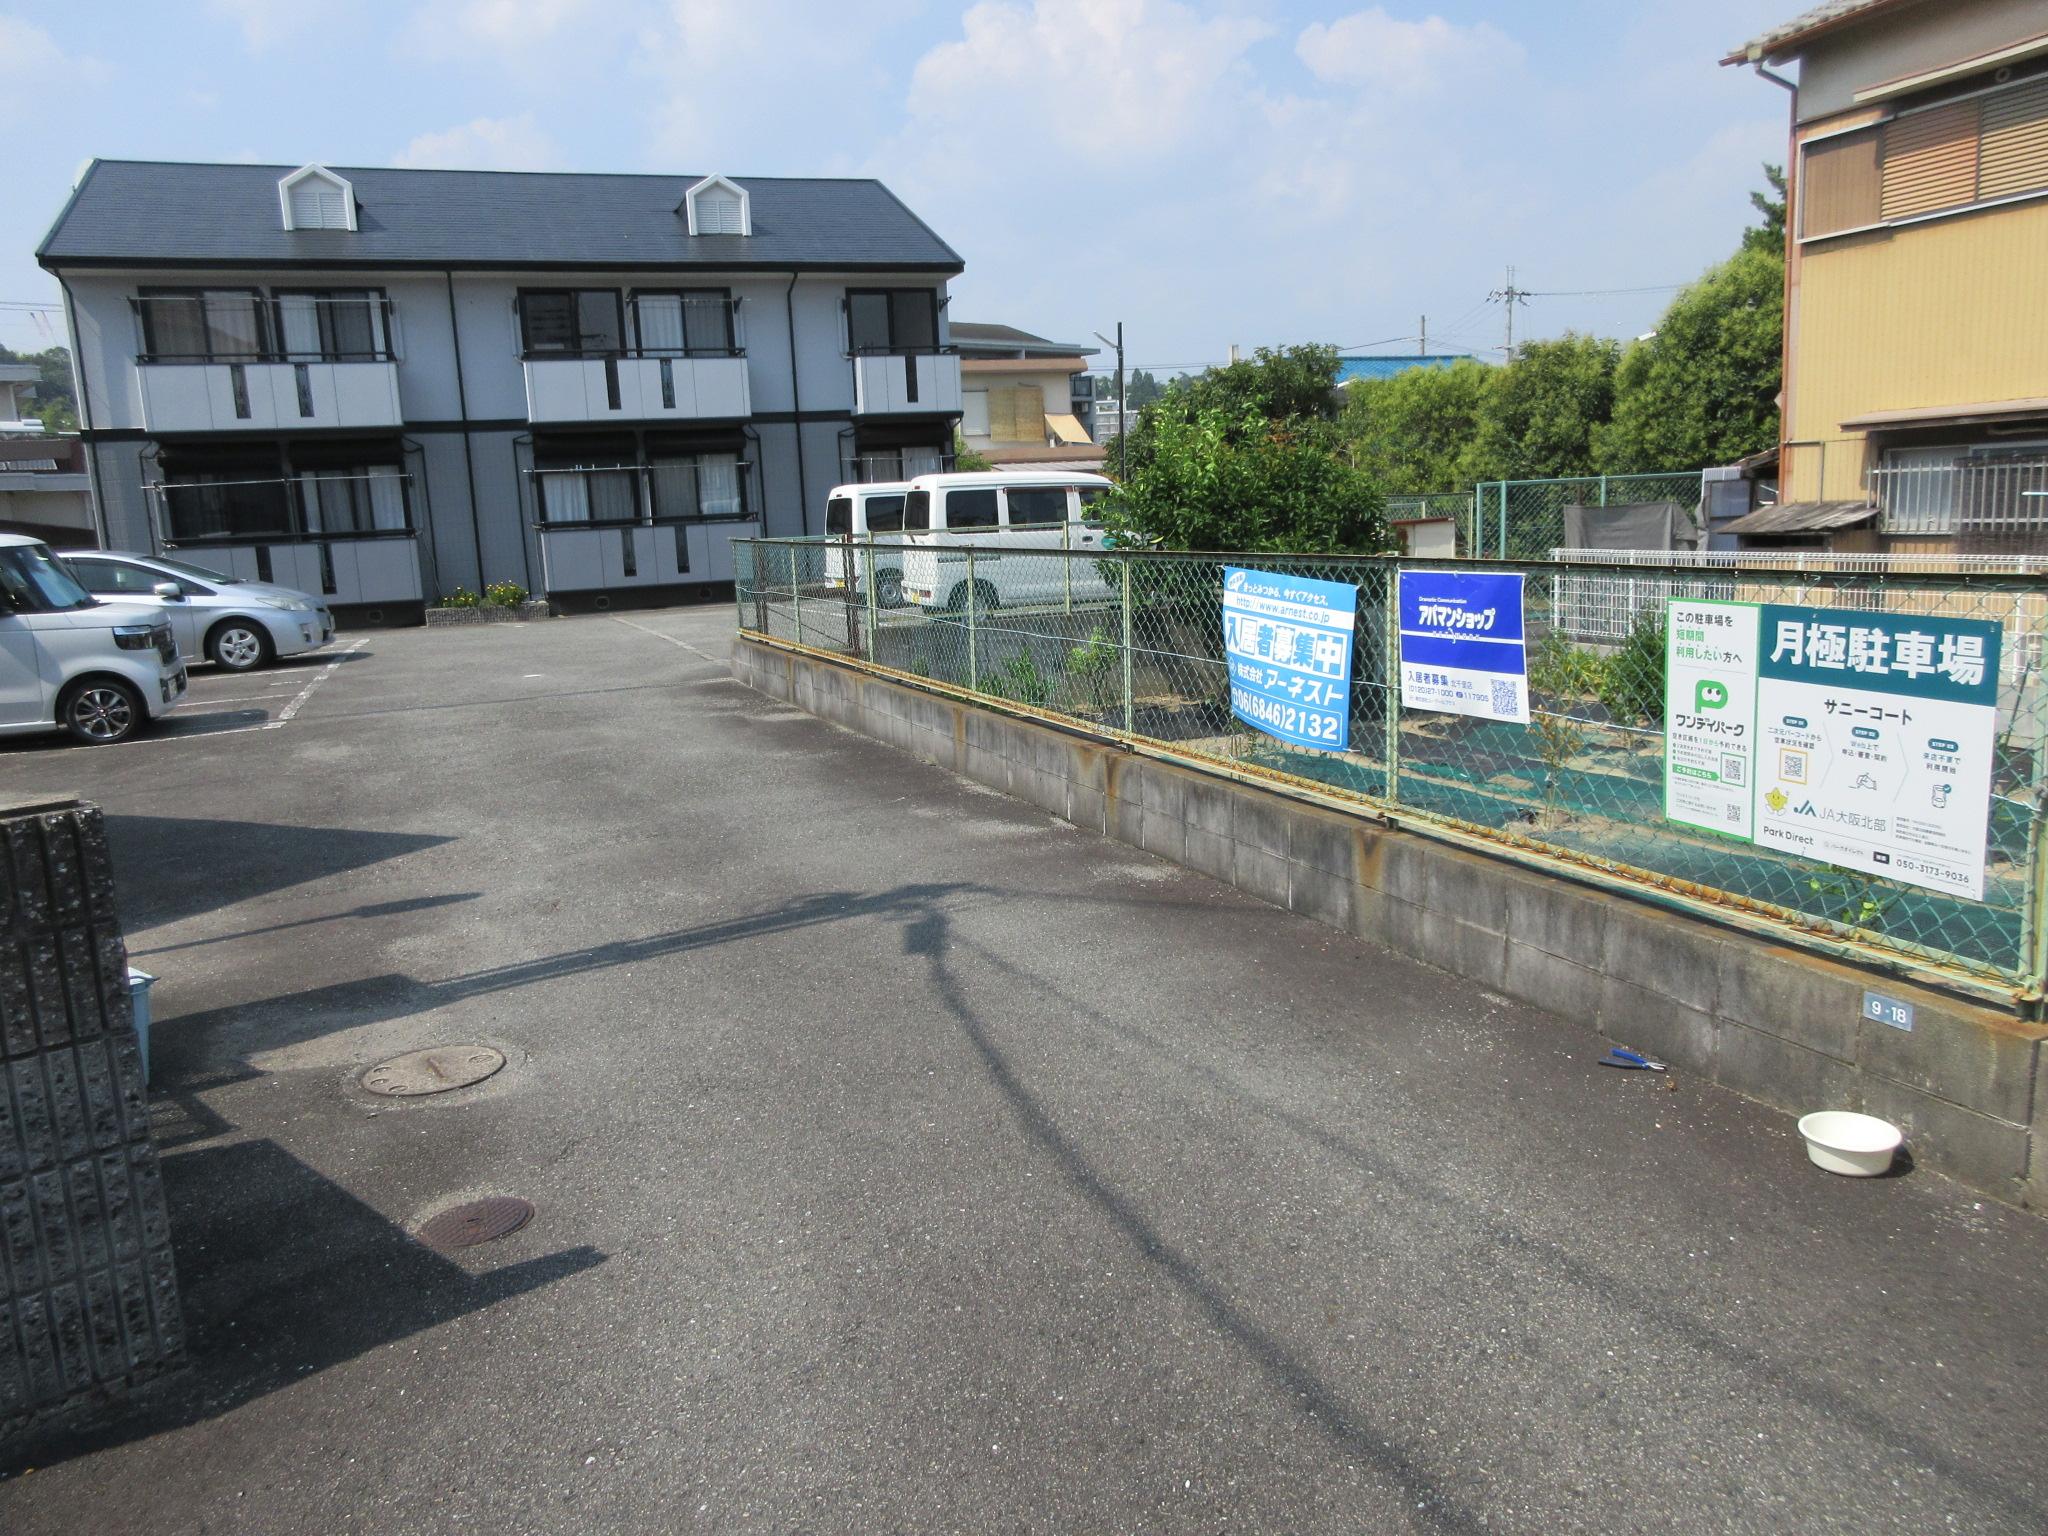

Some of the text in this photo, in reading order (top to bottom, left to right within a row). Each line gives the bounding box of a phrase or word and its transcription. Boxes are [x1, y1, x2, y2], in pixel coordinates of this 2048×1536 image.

[1236, 596, 1330, 624] http://www.arnest.co.jp
[1418, 604, 1496, 631] アパマンショップ
[1676, 612, 1733, 627] この駐車場を
[1226, 616, 1344, 674] 入居者募集中
[1676, 629, 1705, 642] 短期間
[1676, 646, 1743, 663] 利用したい方へ
[1770, 620, 1985, 686] 月極駐車場
[1408, 670, 1450, 687] 入居者募集
[1824, 699, 1913, 726] サニーコート
[1819, 807, 1887, 832] JA大阪北部
[1763, 825, 1814, 846] Park Direct
[1896, 859, 1970, 883] 050-3173-9036
